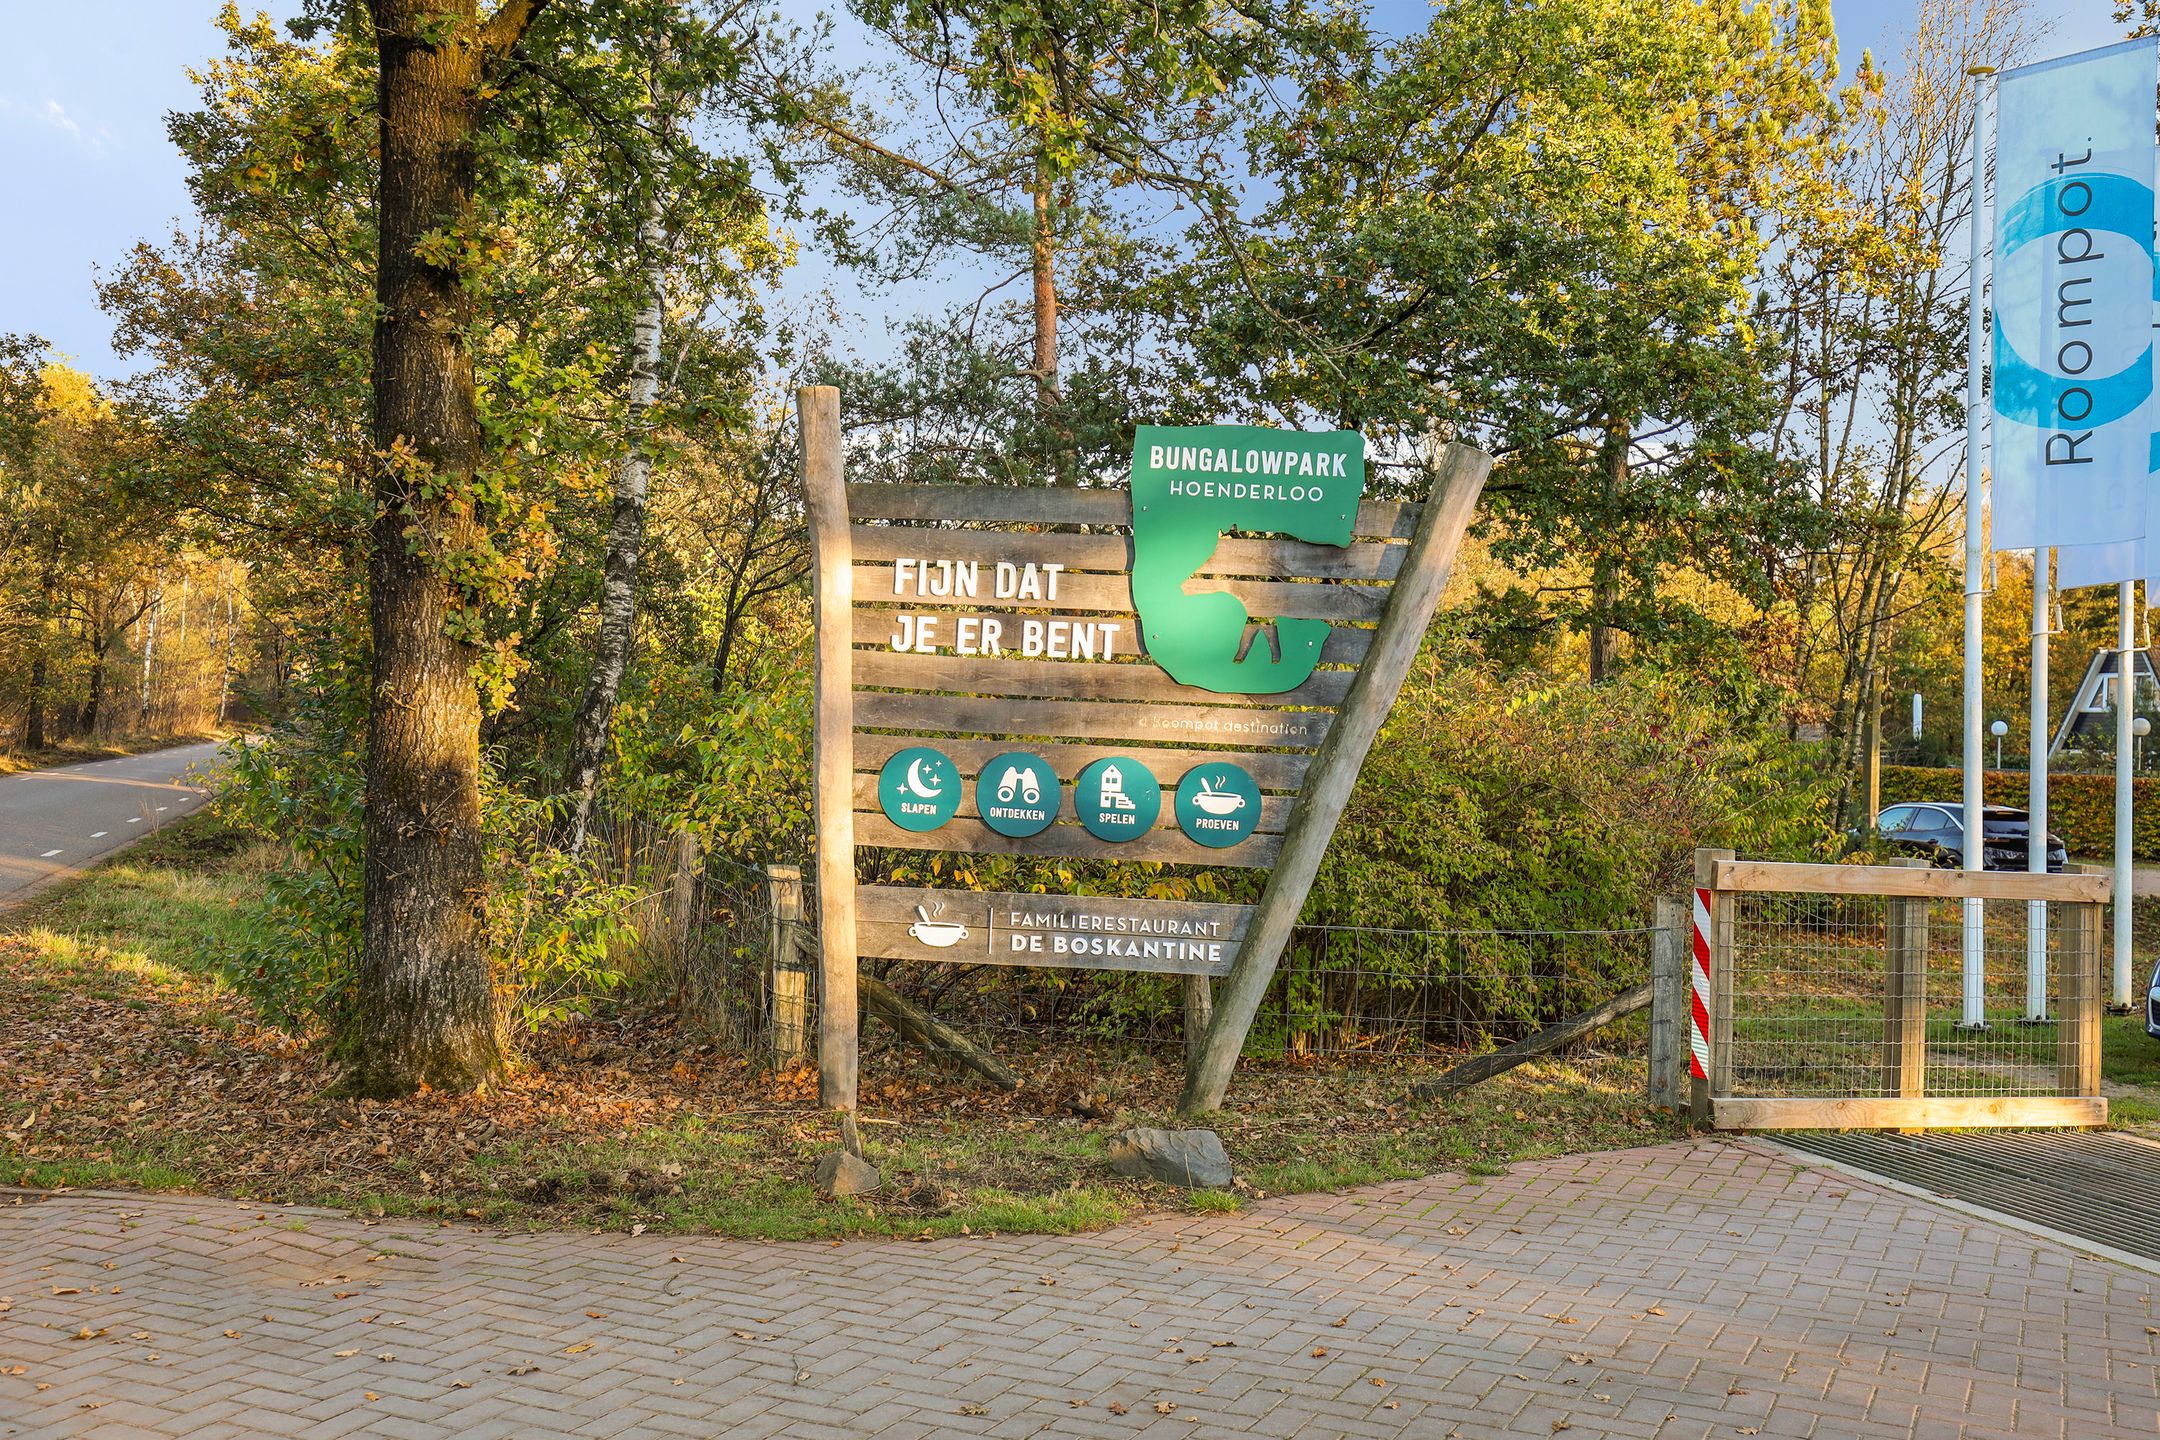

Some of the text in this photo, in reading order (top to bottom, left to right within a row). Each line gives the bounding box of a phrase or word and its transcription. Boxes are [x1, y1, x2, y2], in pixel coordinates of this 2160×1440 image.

[2046, 136, 2105, 466] Roompot.
[1150, 445, 1347, 477] BUNGALOWPARK
[1170, 480, 1323, 502] HOENDERLOO
[894, 558, 1065, 600] FIJN DAT
[891, 615, 1120, 661] JE ER BENT
[1223, 717, 1308, 736] destination
[901, 802, 937, 816] SLAPEN
[990, 806, 1045, 821] ONTDEKKEN
[1099, 812, 1136, 825] SPELEN
[1195, 817, 1240, 831] PROEVEN
[1011, 912, 1221, 937] FAMILIERESTAURANT
[1011, 935, 1221, 962] DE BOSKANTINE
